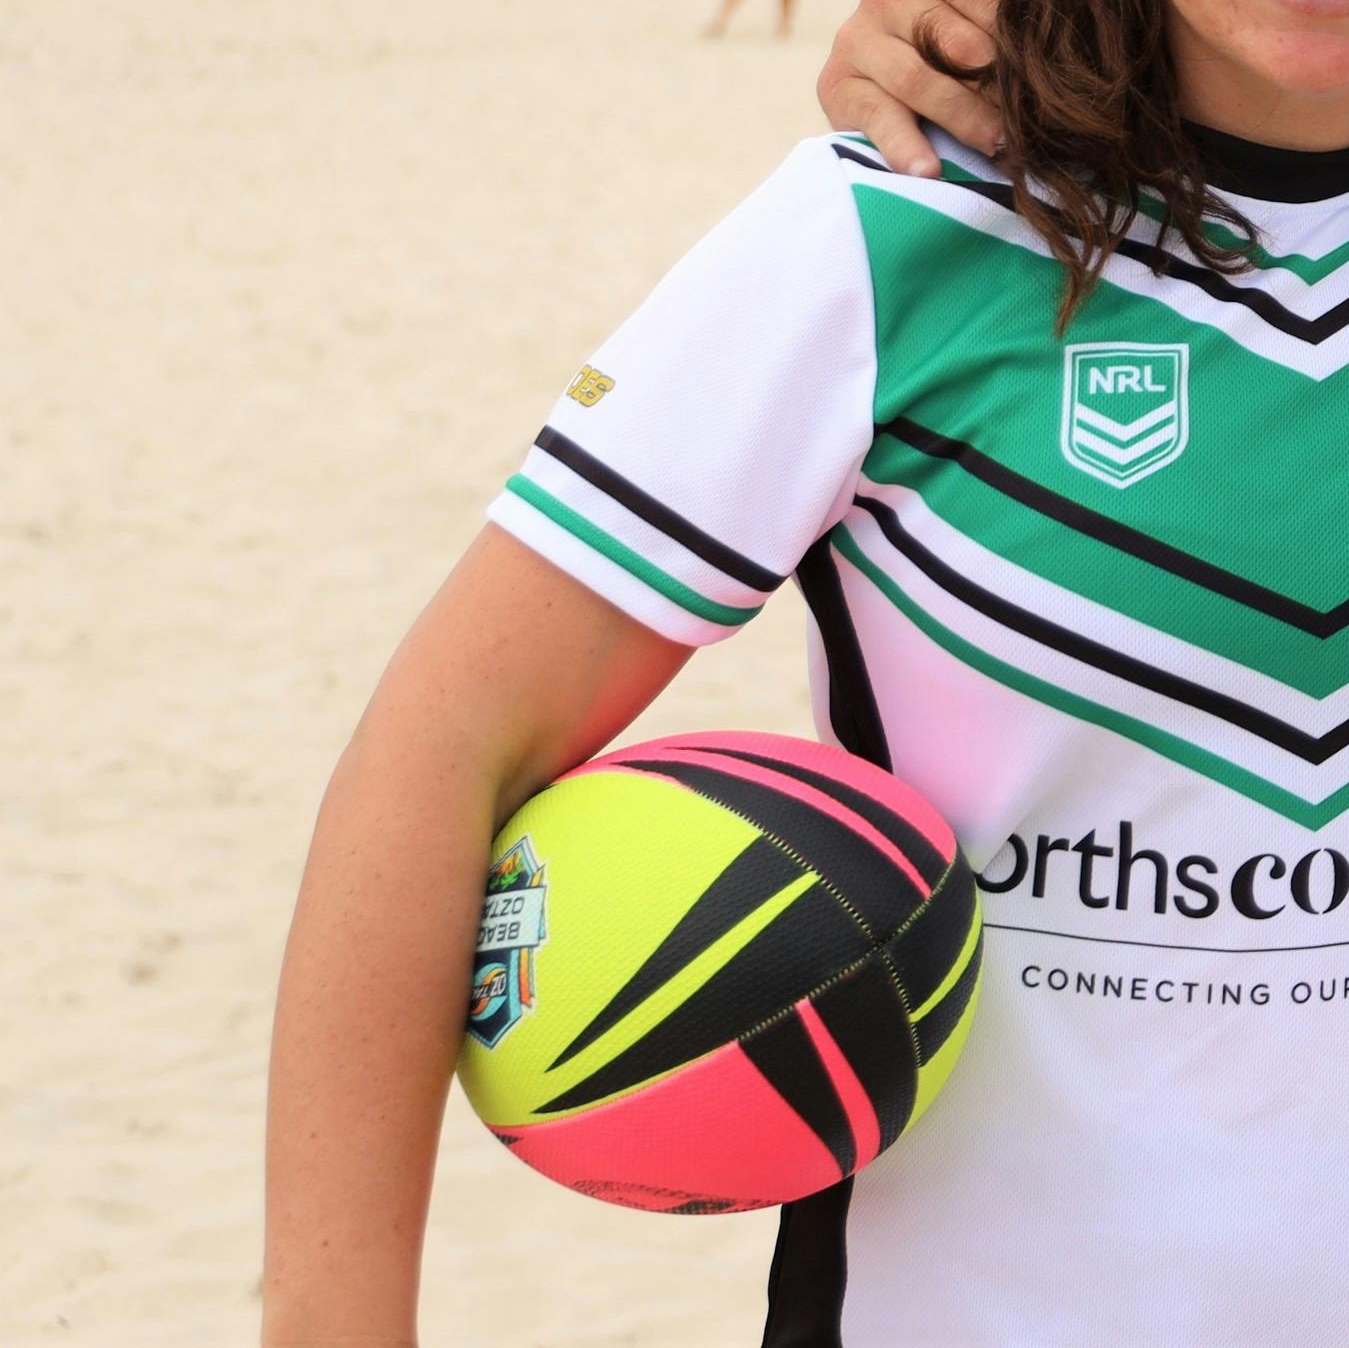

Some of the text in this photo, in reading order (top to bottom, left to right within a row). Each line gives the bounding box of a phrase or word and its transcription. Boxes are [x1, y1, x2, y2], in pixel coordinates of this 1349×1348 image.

[1088, 364, 1167, 395] NRL
[480, 896, 525, 919] OZTA
[477, 921, 521, 946] BEAC
[1022, 965, 1270, 1005] CONNECTING
